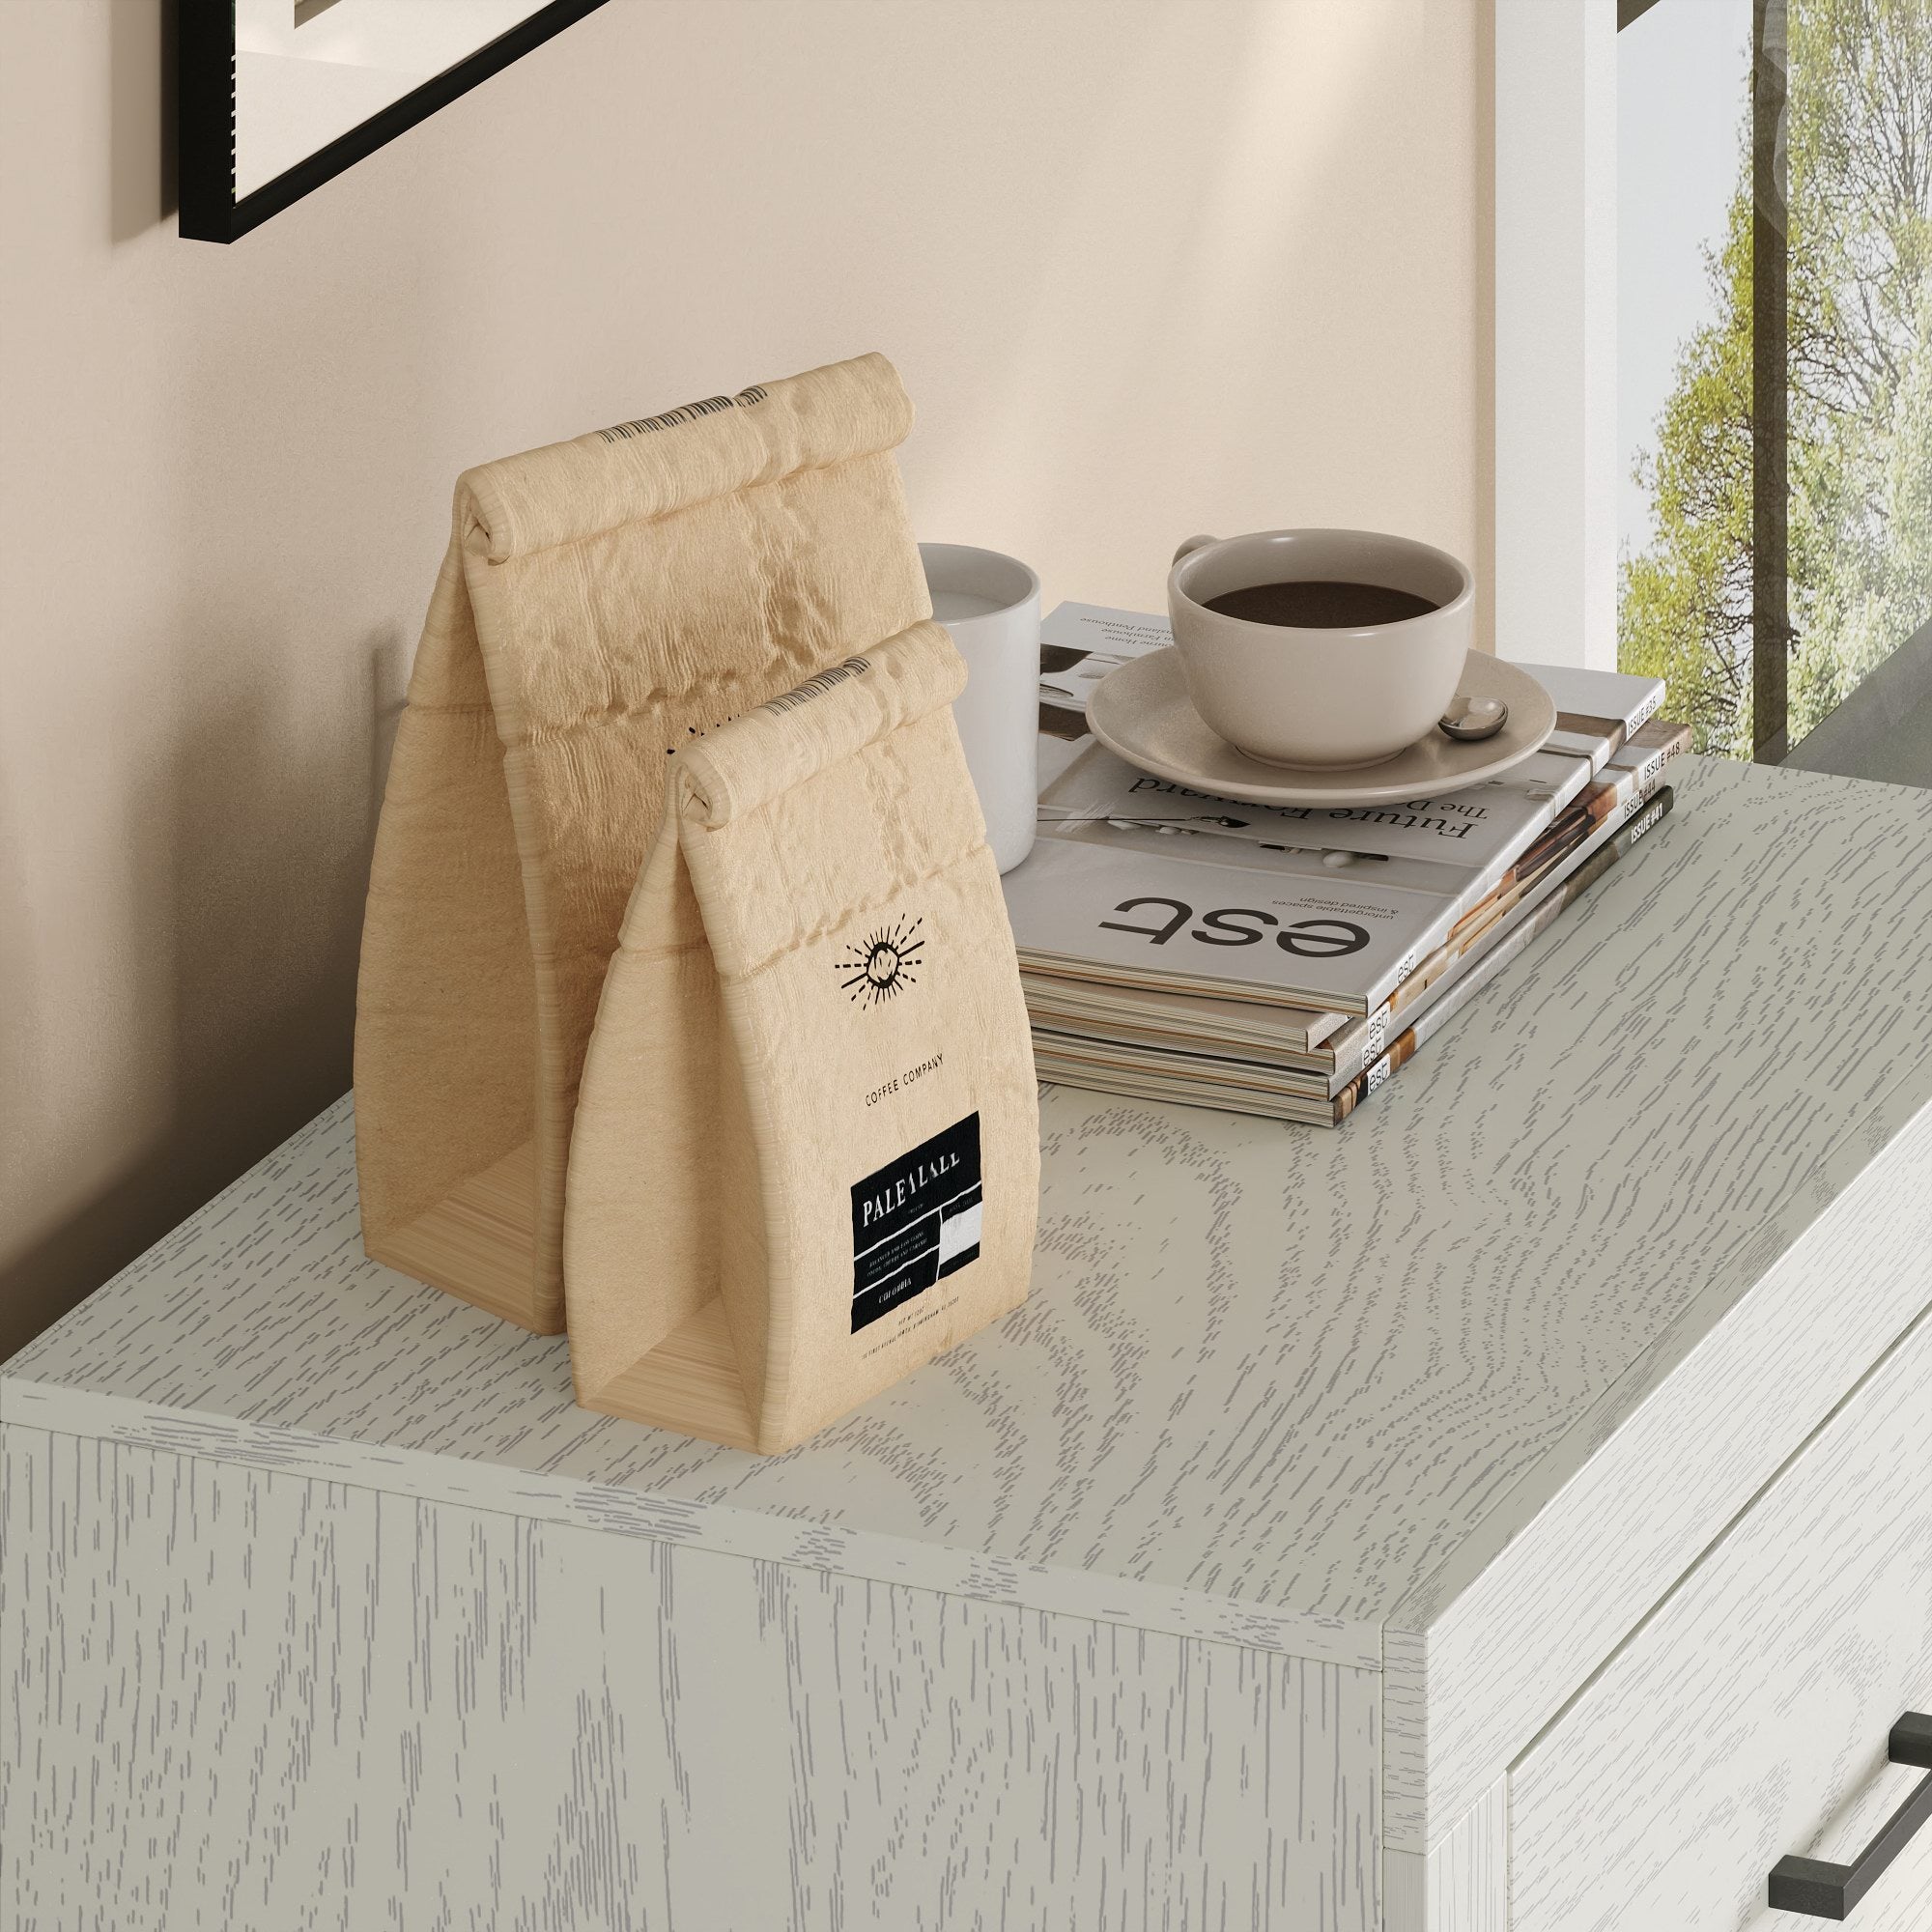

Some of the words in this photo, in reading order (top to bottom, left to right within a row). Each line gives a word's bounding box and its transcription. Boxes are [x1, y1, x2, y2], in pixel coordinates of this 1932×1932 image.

[1627, 703, 1645, 736] ISSUE
[1645, 696, 1658, 715] #35
[1643, 752, 1665, 781] ISSUE
[1666, 741, 1681, 761] #48
[1128, 777, 1315, 820] Fard
[1440, 803, 1491, 820] The
[1624, 788, 1643, 819] ISSUE
[1328, 808, 1479, 839] Future
[1631, 812, 1651, 845] ISSUE
[1650, 802, 1663, 826] #41
[1271, 899, 1314, 909] spaces
[1299, 896, 1340, 906] design
[1315, 905, 1395, 920] unforgettable
[1340, 901, 1388, 914] inspired
[1097, 896, 1371, 958] est
[1397, 952, 1414, 984] est
[1369, 1009, 1388, 1040] est
[1363, 1037, 1382, 1067] est
[865, 1079, 899, 1107] COFFEE
[902, 1053, 944, 1086] COMPANY
[1369, 1063, 1388, 1093] est
